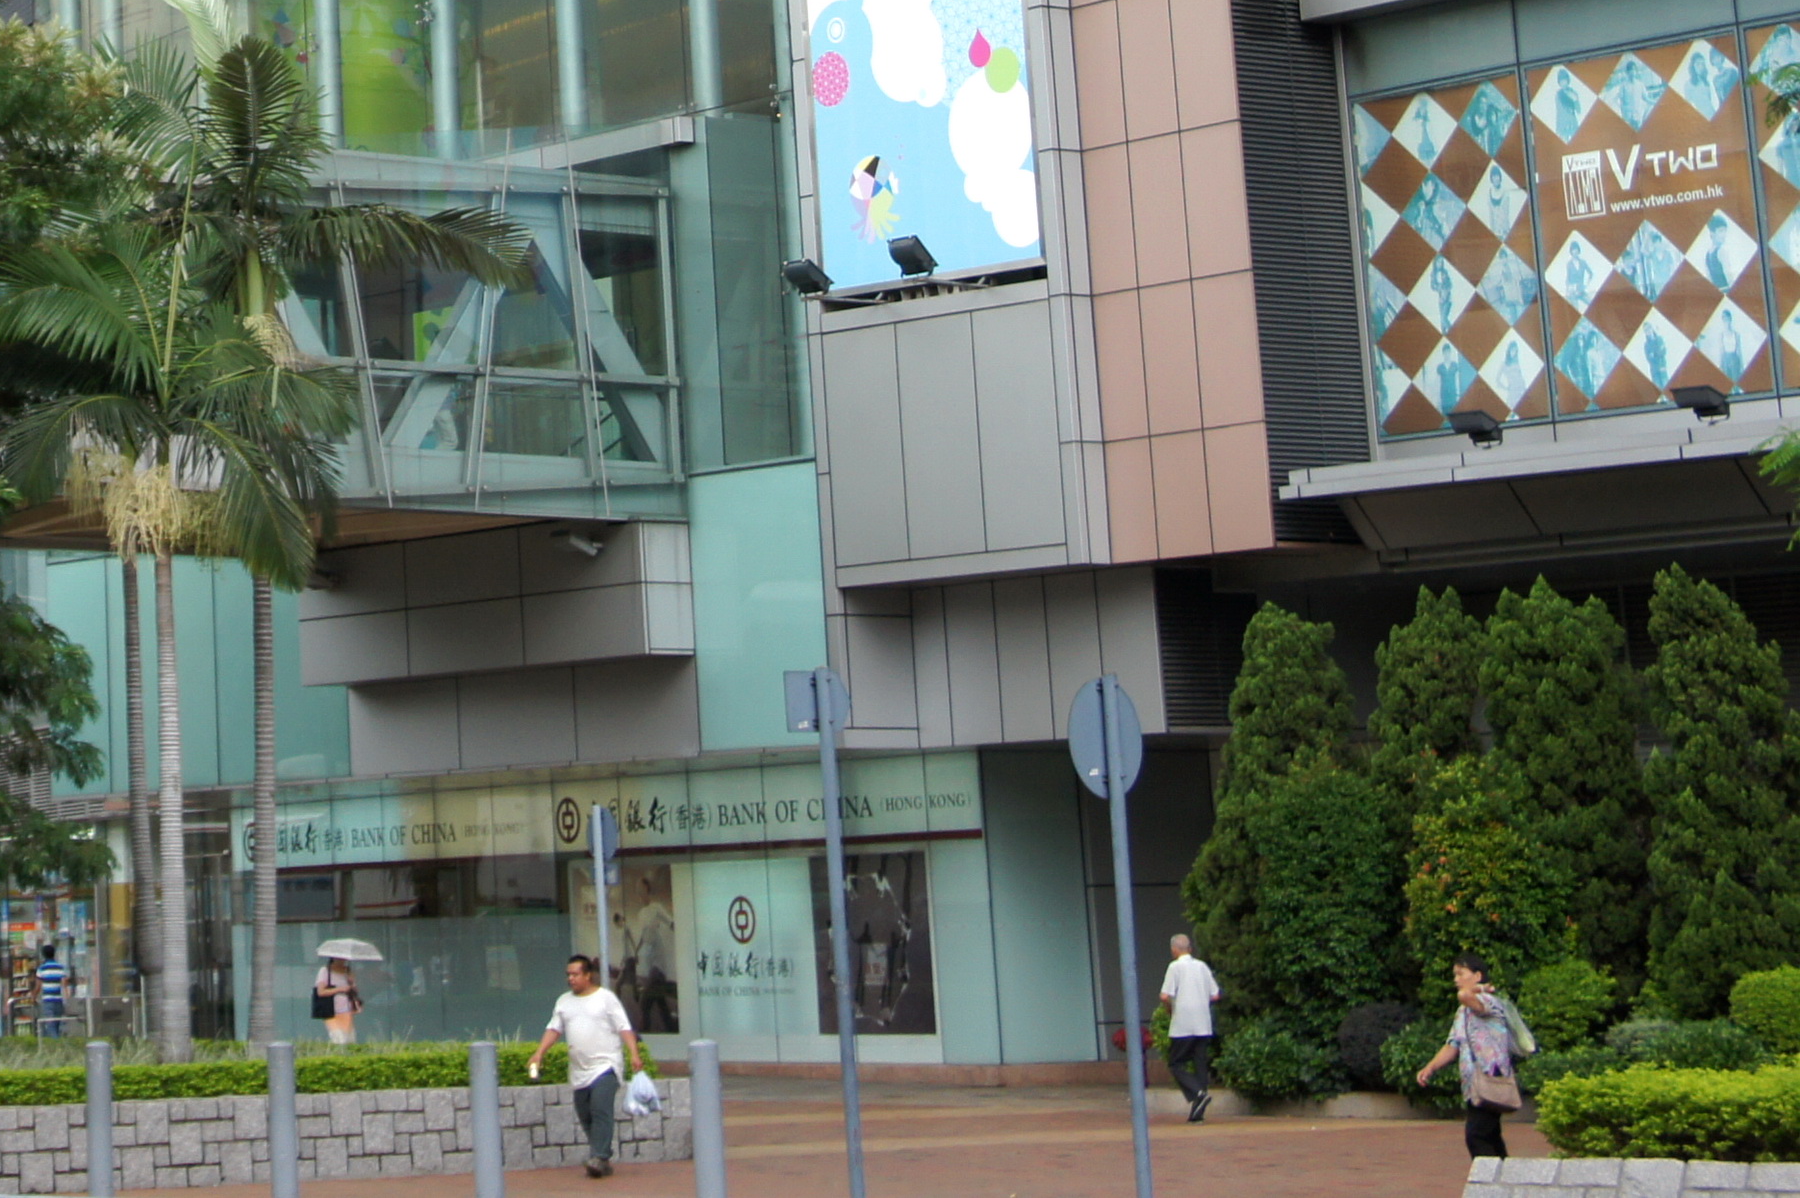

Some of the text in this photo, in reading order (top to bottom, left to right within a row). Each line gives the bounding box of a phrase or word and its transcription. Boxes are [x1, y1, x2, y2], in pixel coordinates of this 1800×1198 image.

[1610, 183, 1724, 213] www.vtwo.com.hk
[718, 801, 767, 827] BANK
[775, 800, 798, 823] OF
[807, 795, 873, 821] CINA
[351, 827, 385, 849] BANK
[390, 825, 406, 845] OF
[411, 822, 457, 845] CHINA
